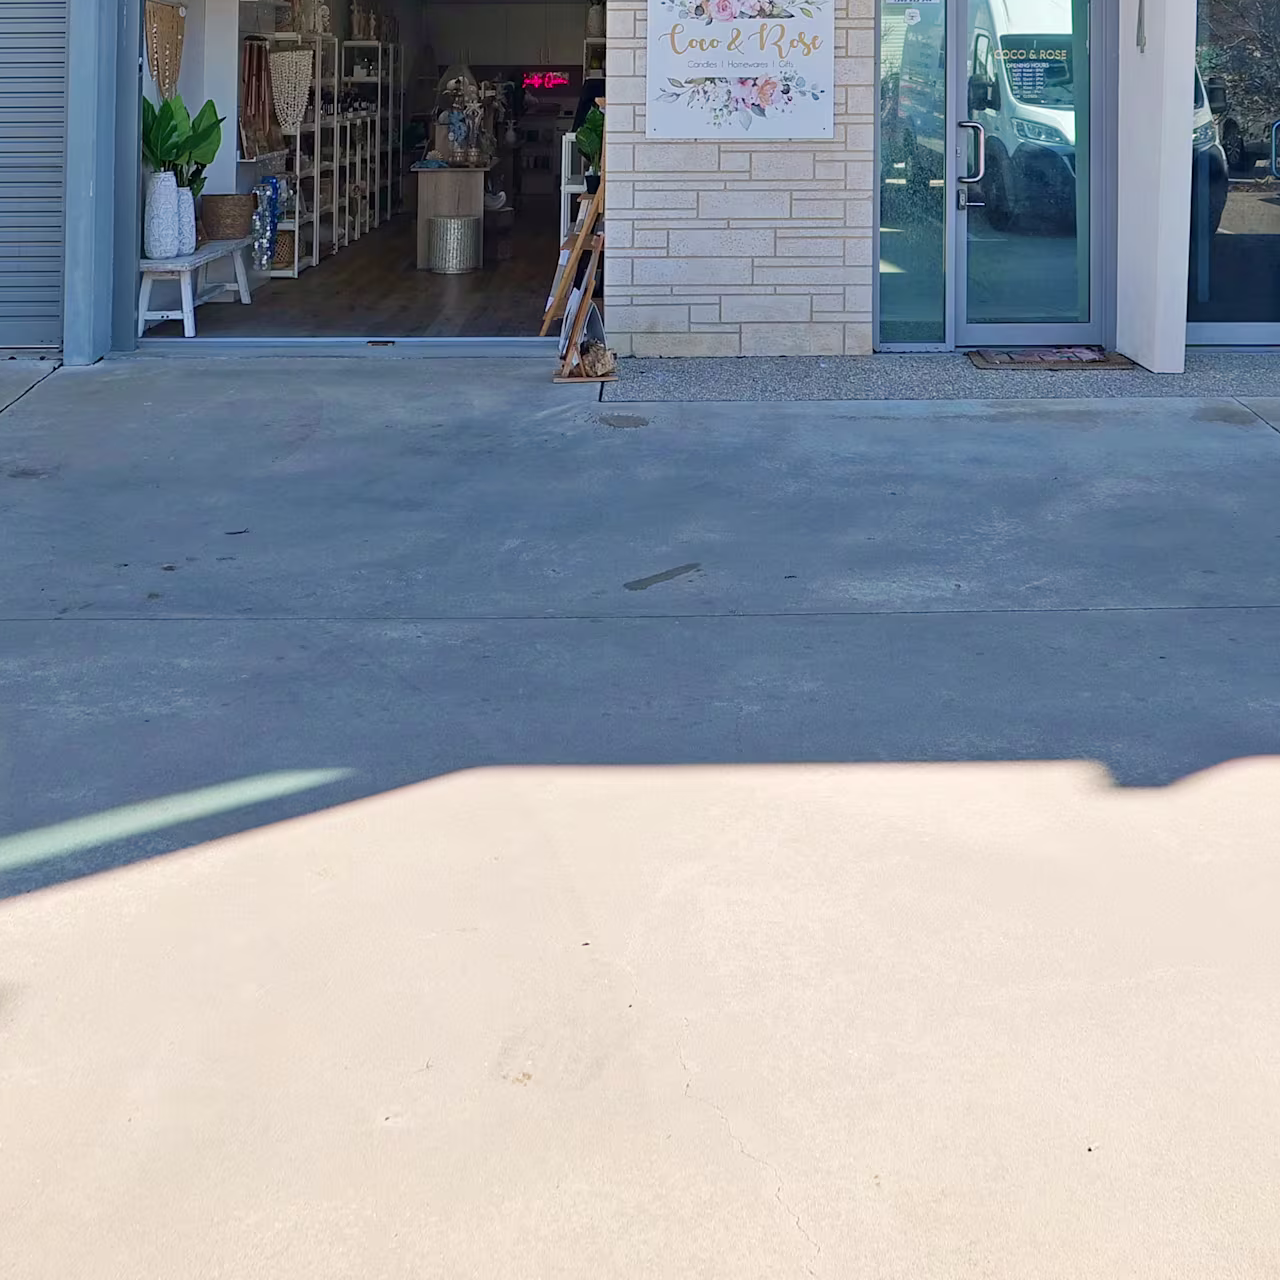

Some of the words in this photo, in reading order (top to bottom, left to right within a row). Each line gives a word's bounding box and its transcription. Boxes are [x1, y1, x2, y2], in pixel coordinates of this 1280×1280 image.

[658, 23, 722, 56] Coco
[726, 27, 745, 56] &
[748, 23, 824, 60] Rose
[993, 49, 1027, 60] COCO
[1028, 49, 1037, 60] &
[1039, 49, 1067, 60] ROSE
[687, 60, 718, 68] Candles
[727, 60, 769, 68] Homewares
[778, 60, 794, 68] Gifts
